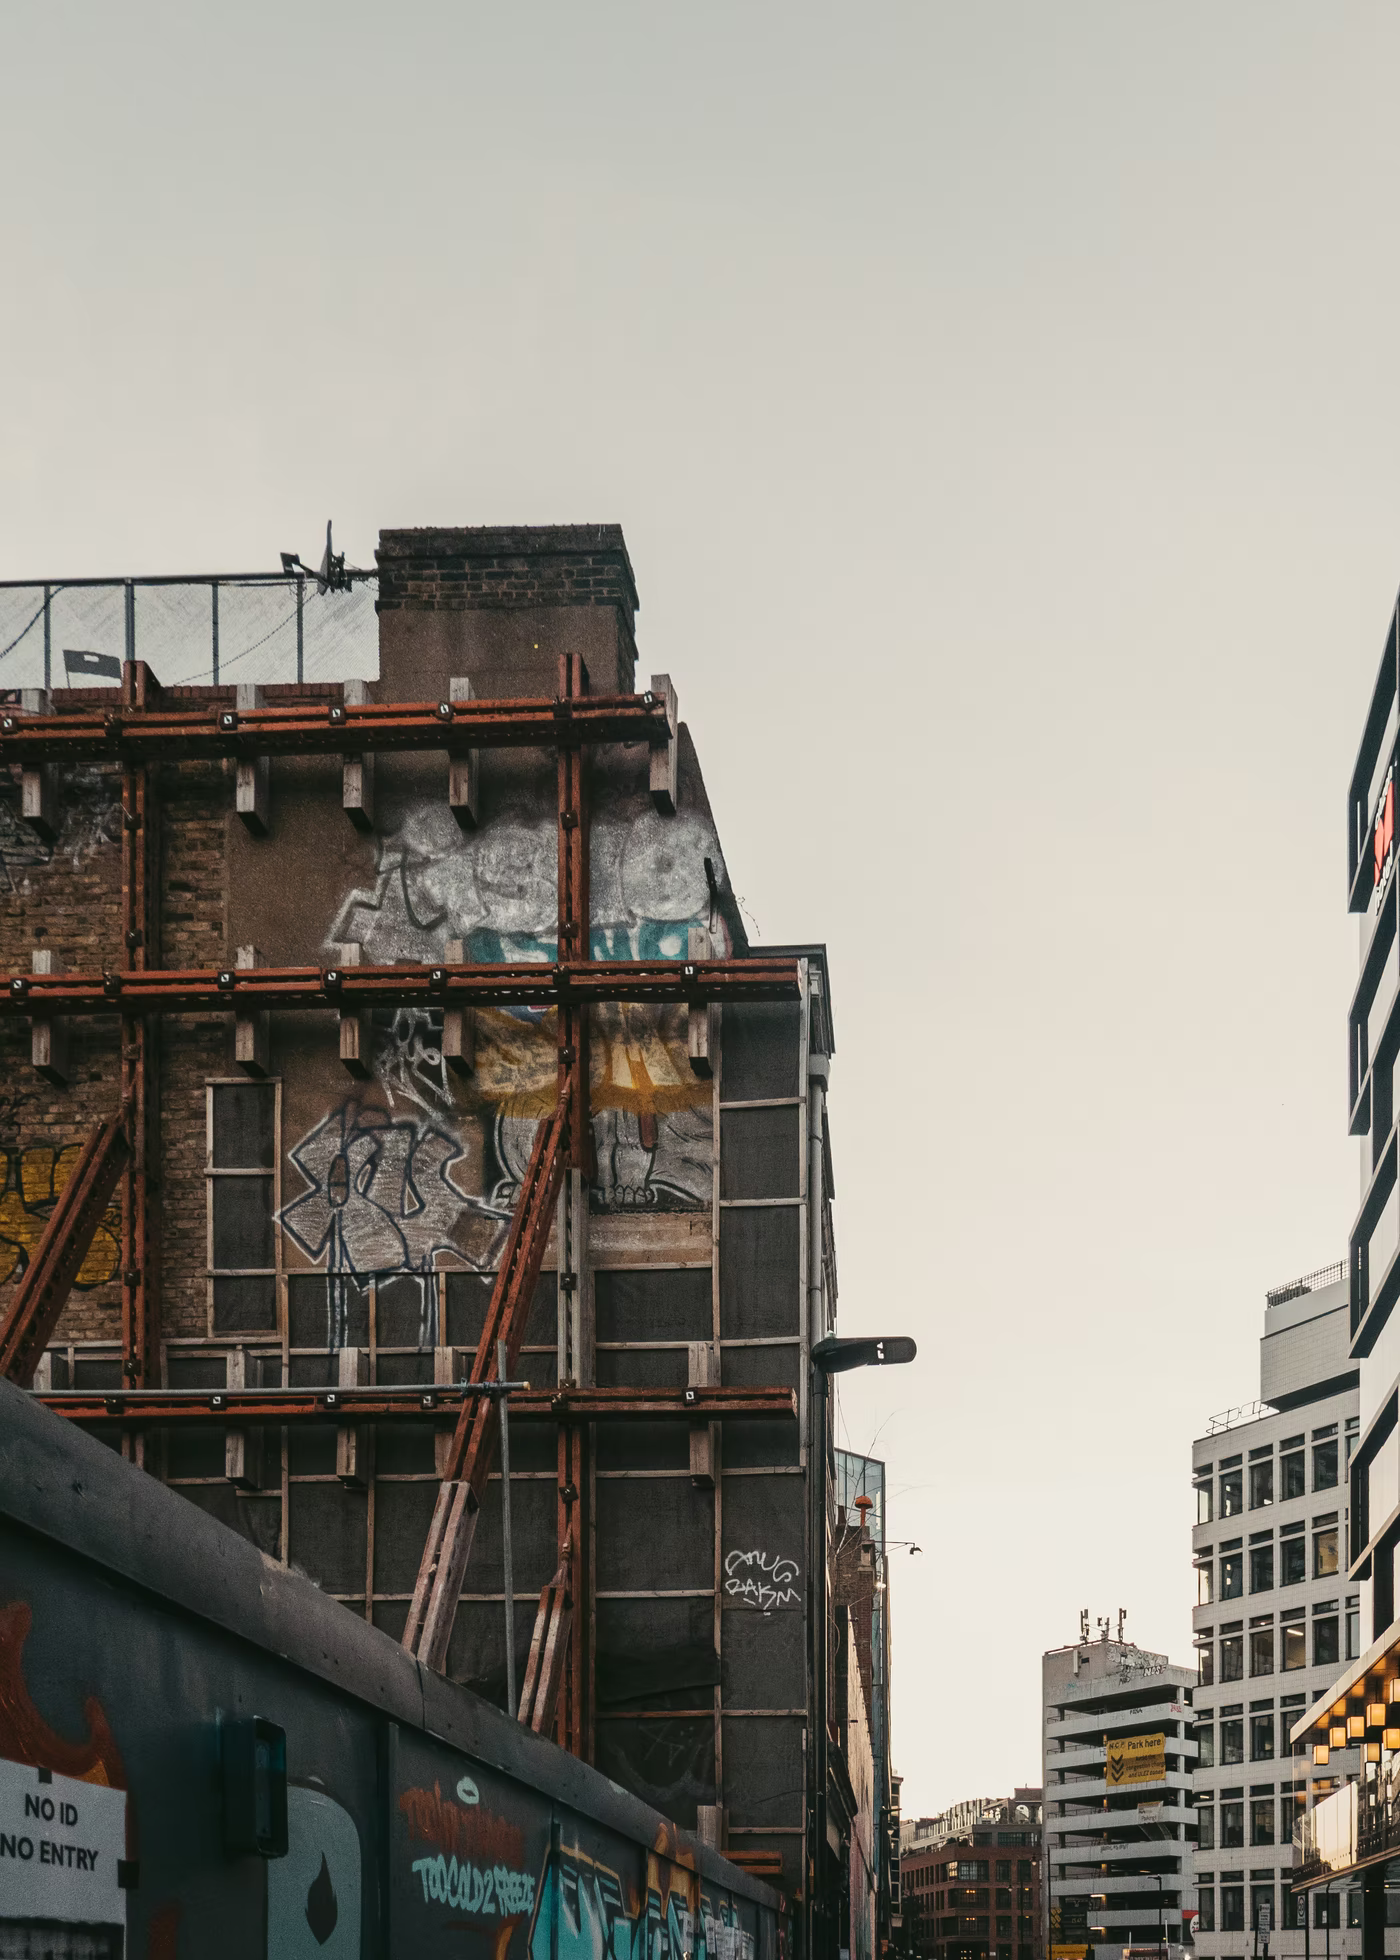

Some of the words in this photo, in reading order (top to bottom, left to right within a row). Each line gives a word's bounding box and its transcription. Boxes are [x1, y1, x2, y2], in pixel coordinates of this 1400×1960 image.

[1128, 1740, 1144, 1750] Park
[1145, 1738, 1161, 1747] here
[25, 1793, 55, 1821] NO
[60, 1801, 78, 1827] ID
[0, 1832, 34, 1860] NO
[40, 1840, 99, 1872] ENTRY
